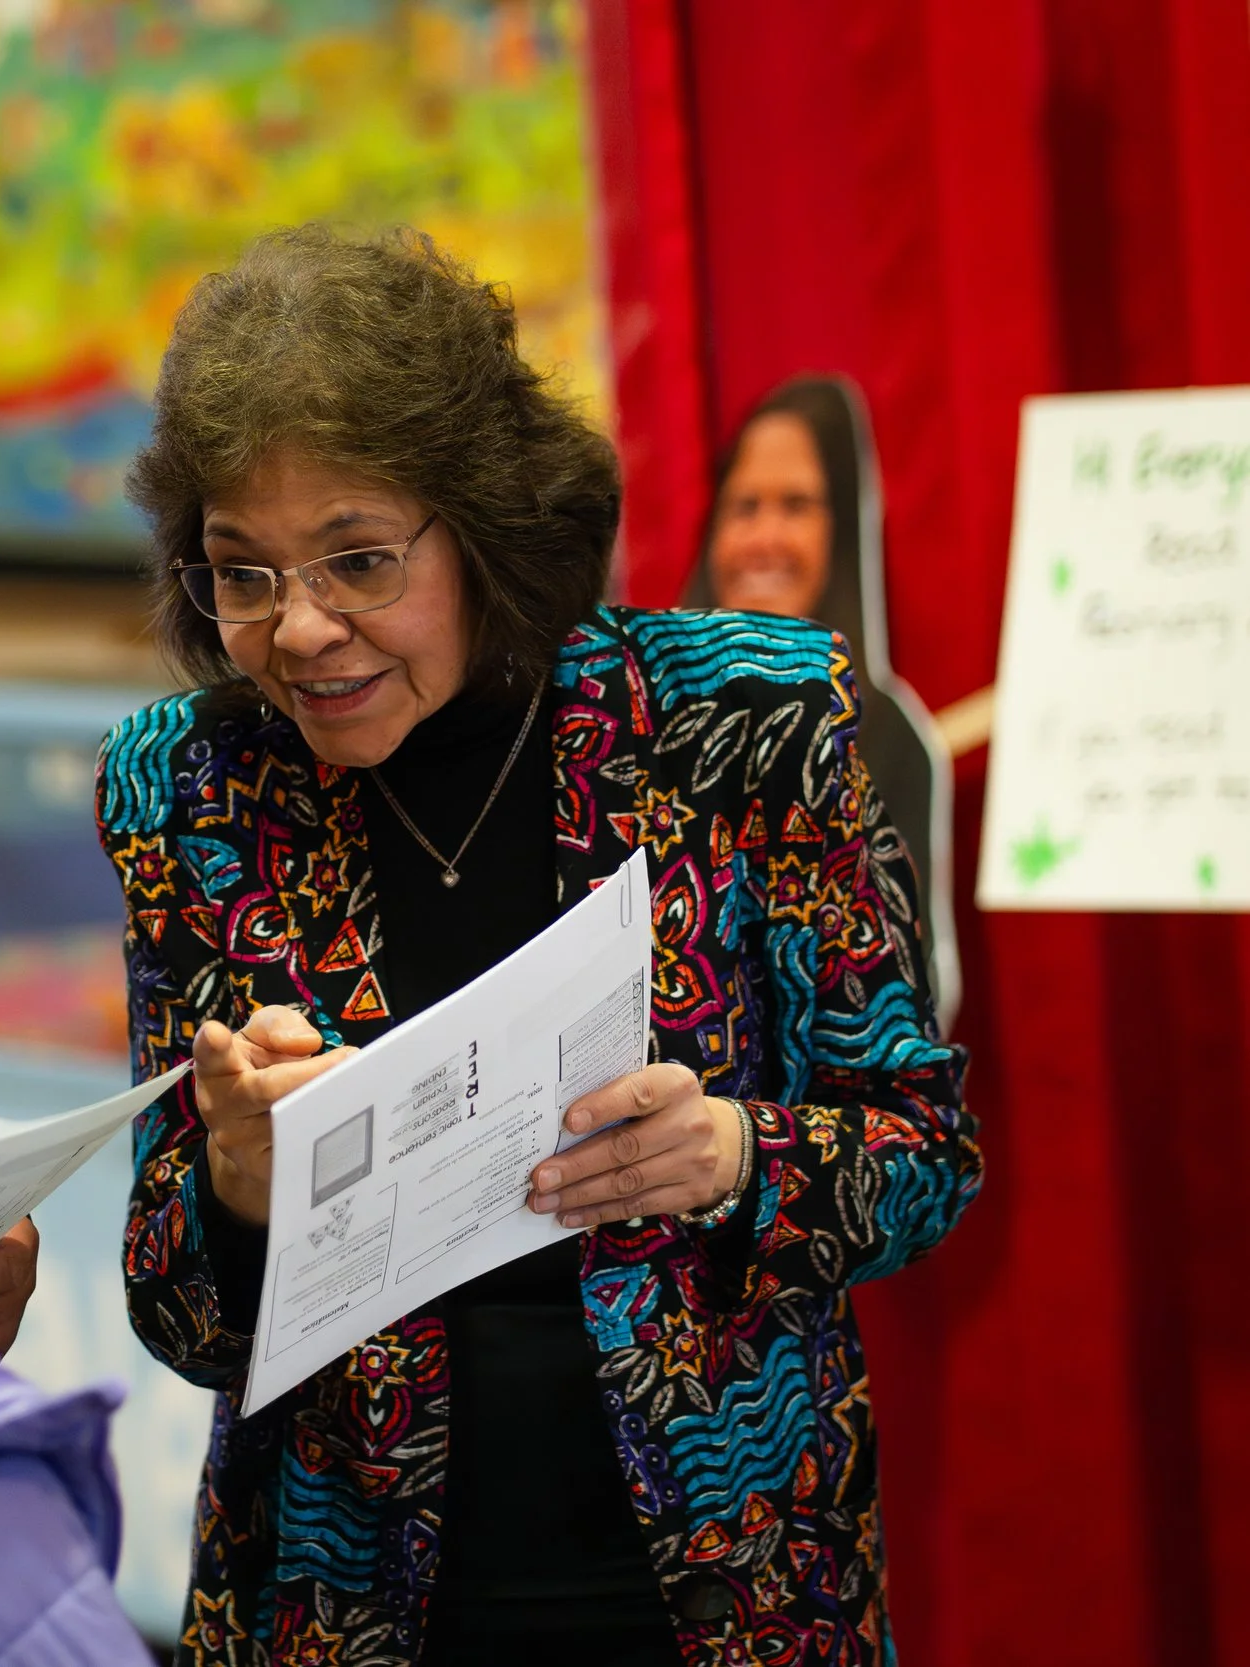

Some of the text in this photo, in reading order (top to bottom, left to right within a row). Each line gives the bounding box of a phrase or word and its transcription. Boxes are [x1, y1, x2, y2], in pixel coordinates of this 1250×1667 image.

[412, 1067, 447, 1094] ENDING
[506, 1113, 543, 1140] EXPLICACIÓN
[446, 1223, 479, 1247] Escritura
[301, 1301, 349, 1333] Matemáticas
